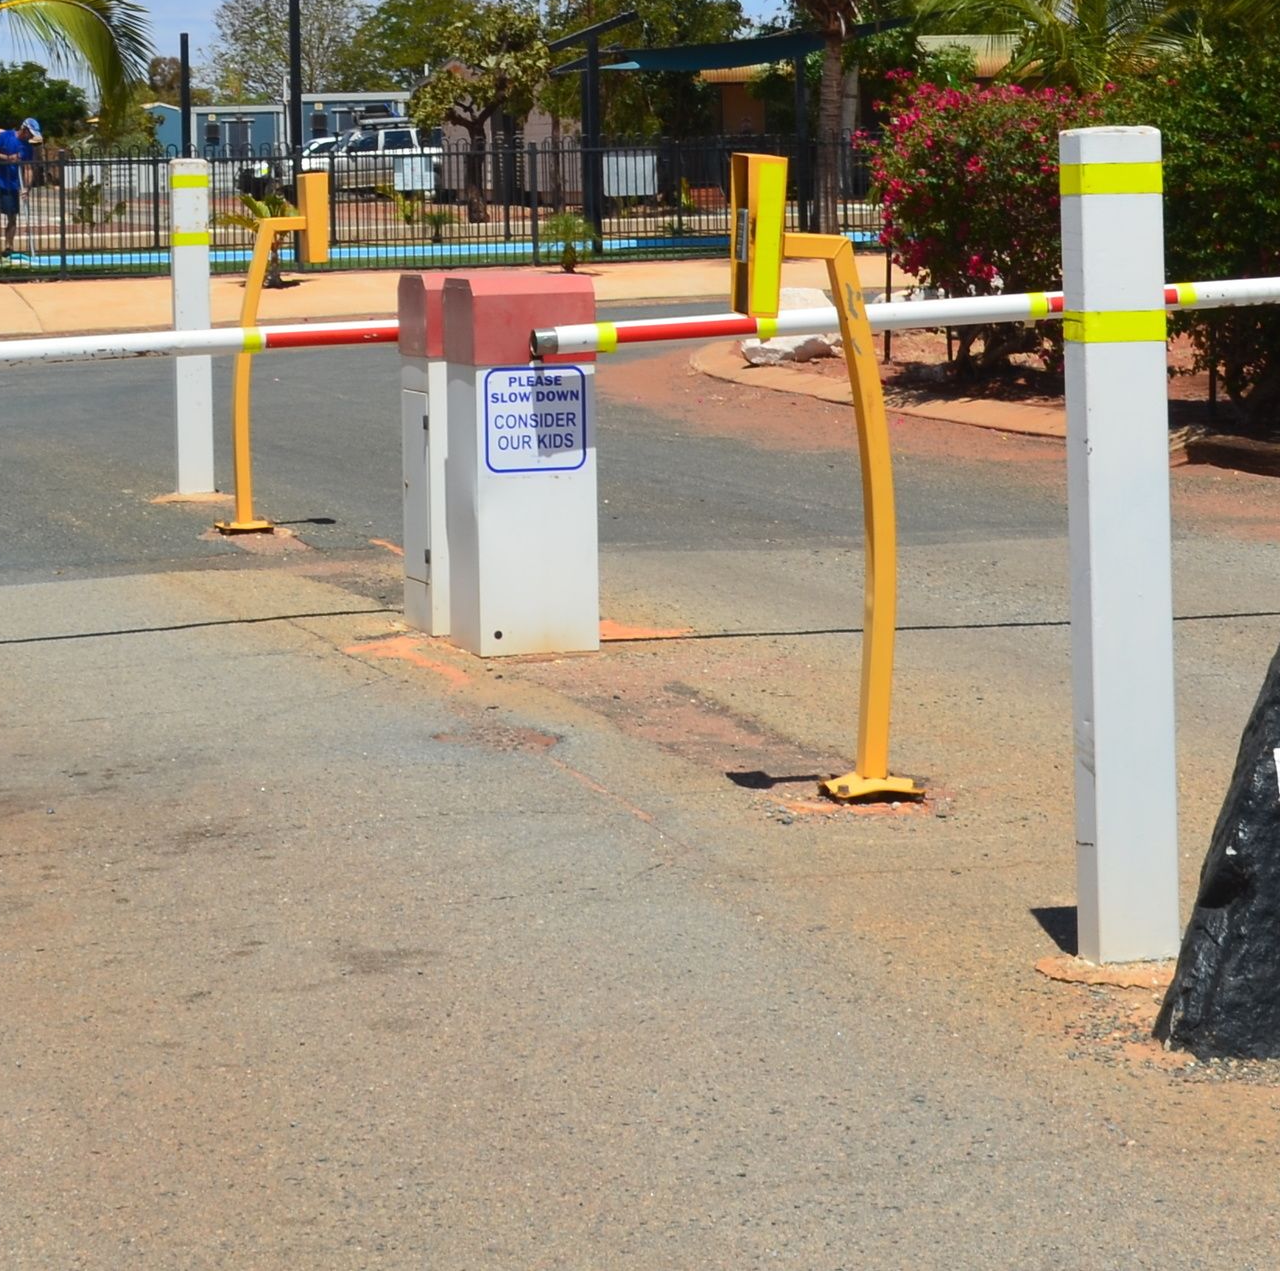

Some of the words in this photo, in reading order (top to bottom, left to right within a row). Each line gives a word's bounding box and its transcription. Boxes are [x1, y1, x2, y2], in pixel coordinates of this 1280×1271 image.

[508, 376, 562, 387] PLEASE
[490, 392, 532, 404] SLOW
[535, 390, 580, 403] DOWN
[494, 412, 577, 430] CONSIDER
[497, 434, 532, 450] OUR
[537, 433, 574, 449] KIDS
